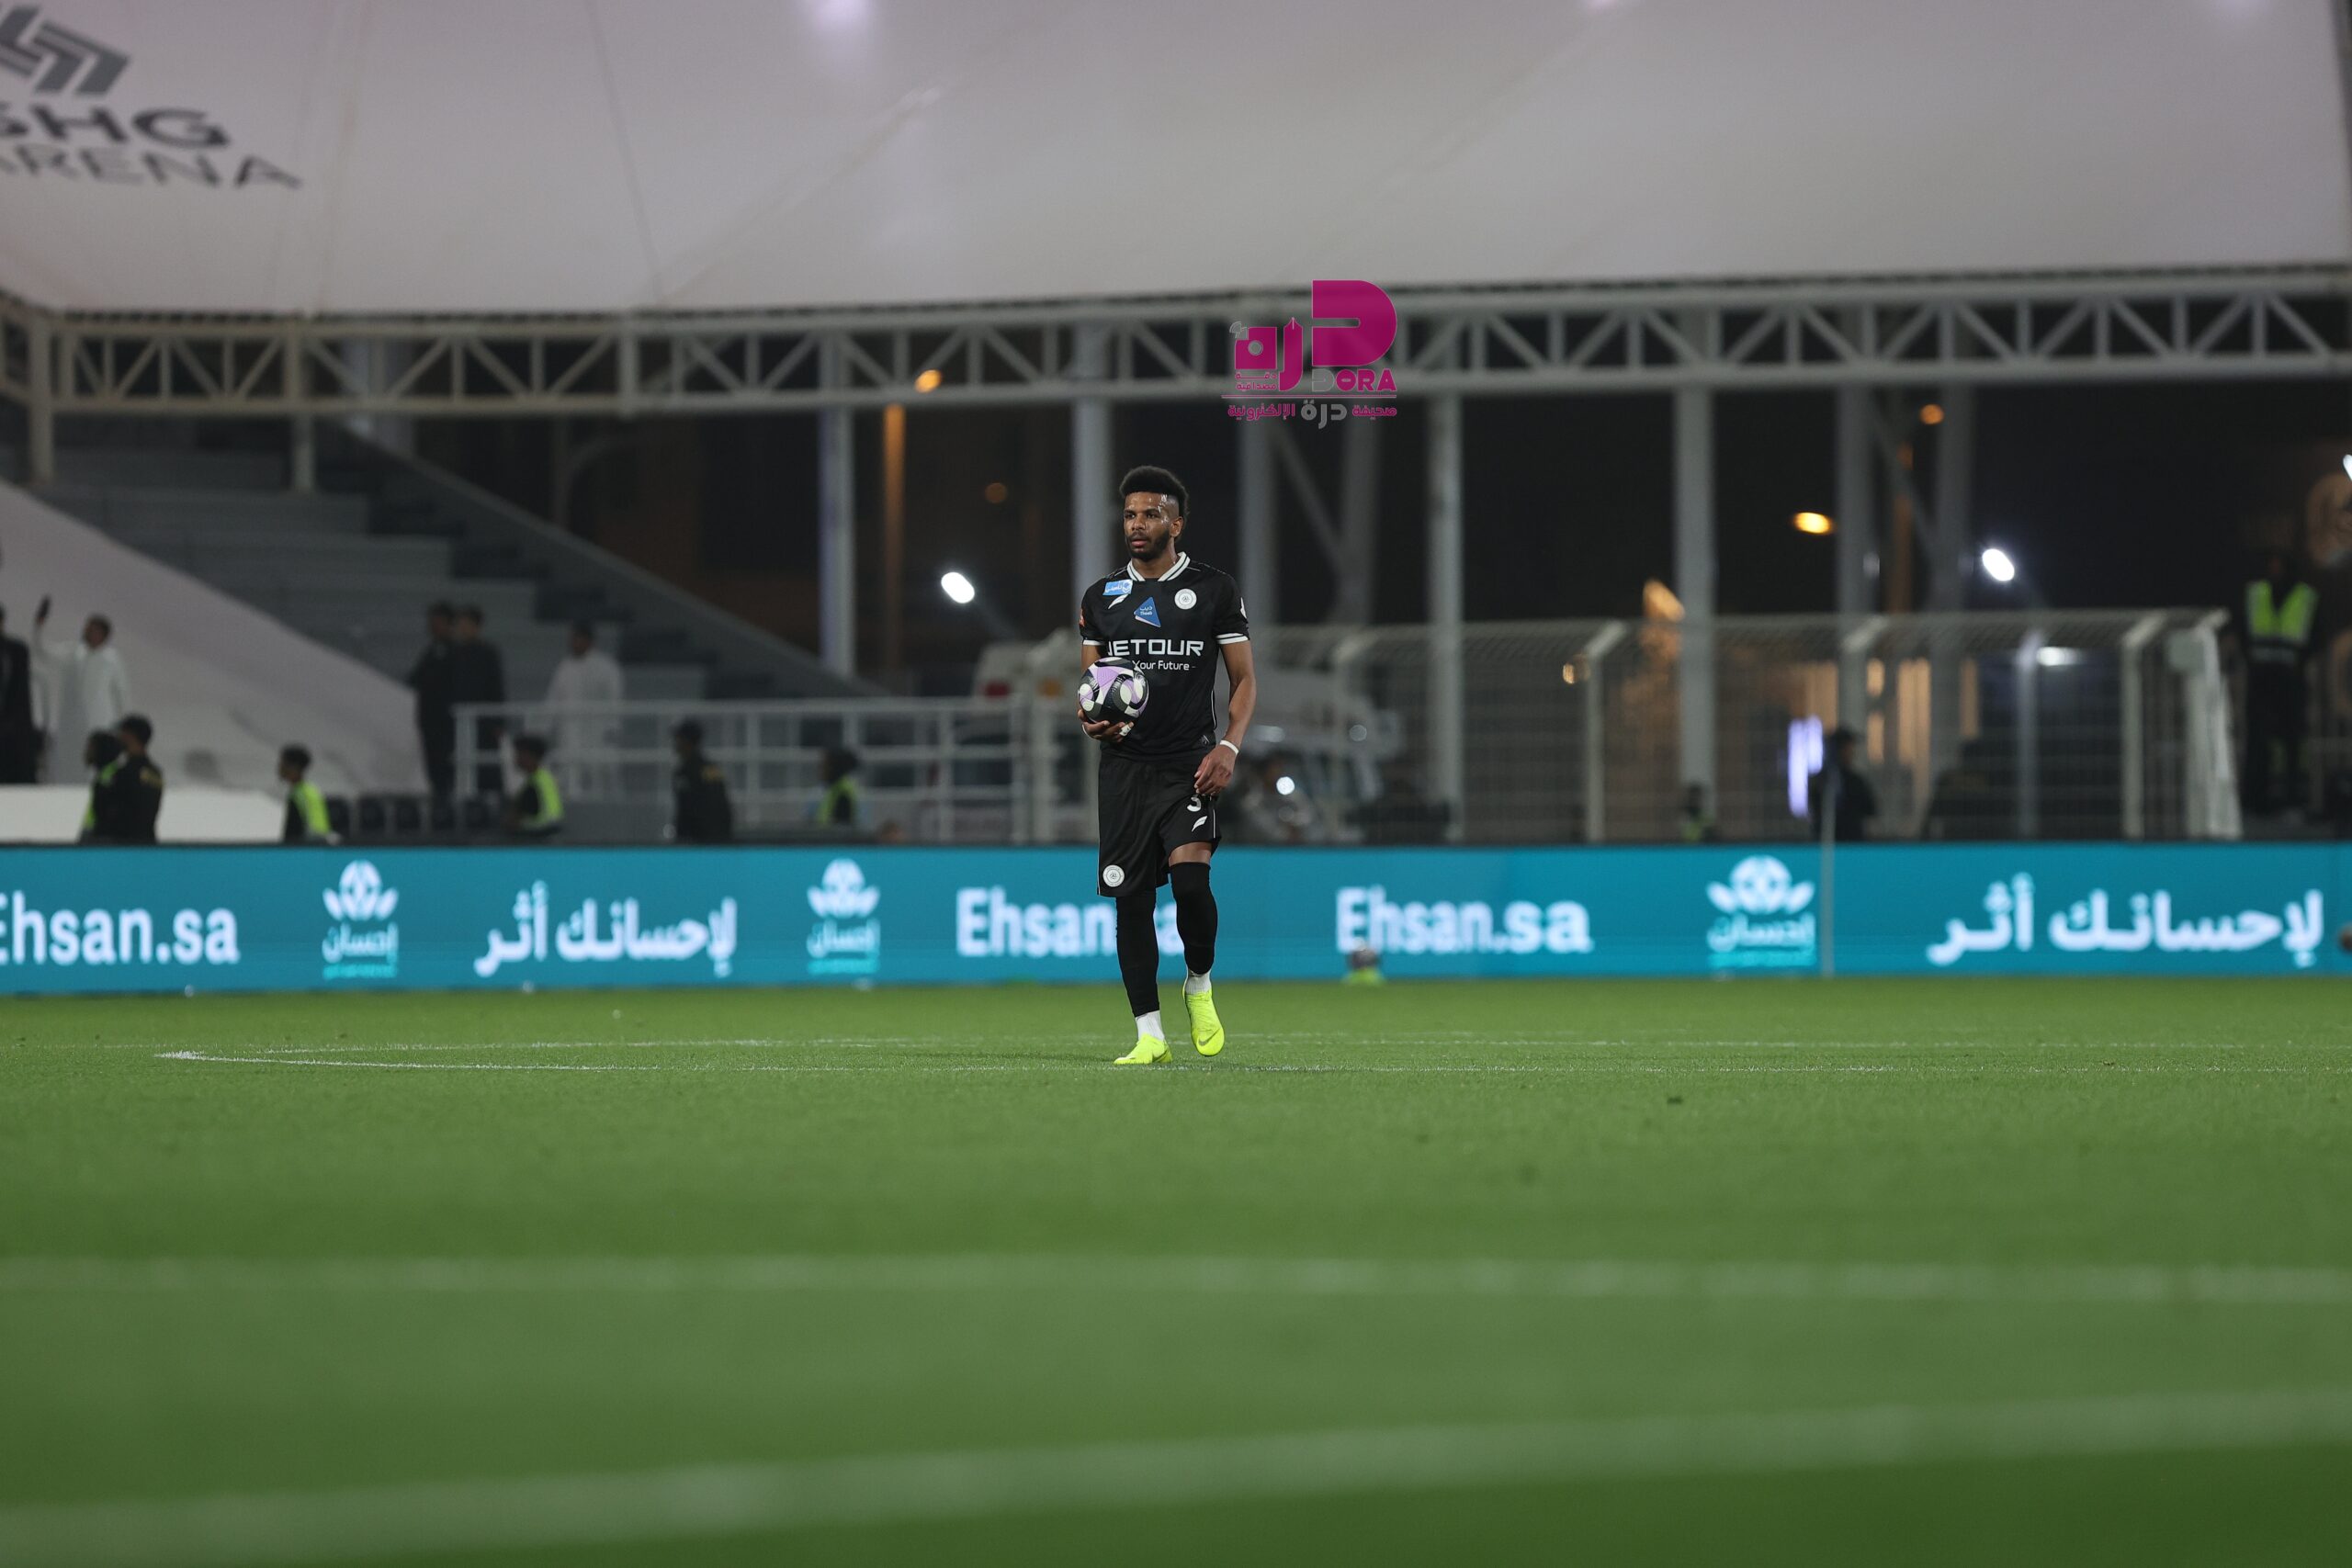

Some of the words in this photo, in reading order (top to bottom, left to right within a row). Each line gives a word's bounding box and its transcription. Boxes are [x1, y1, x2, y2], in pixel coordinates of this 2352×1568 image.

[1132, 660, 1156, 670] Your
[1158, 660, 1190, 671] Future
[956, 886, 1184, 958] Ehsana
[1336, 885, 1594, 954] Ehsan.sa
